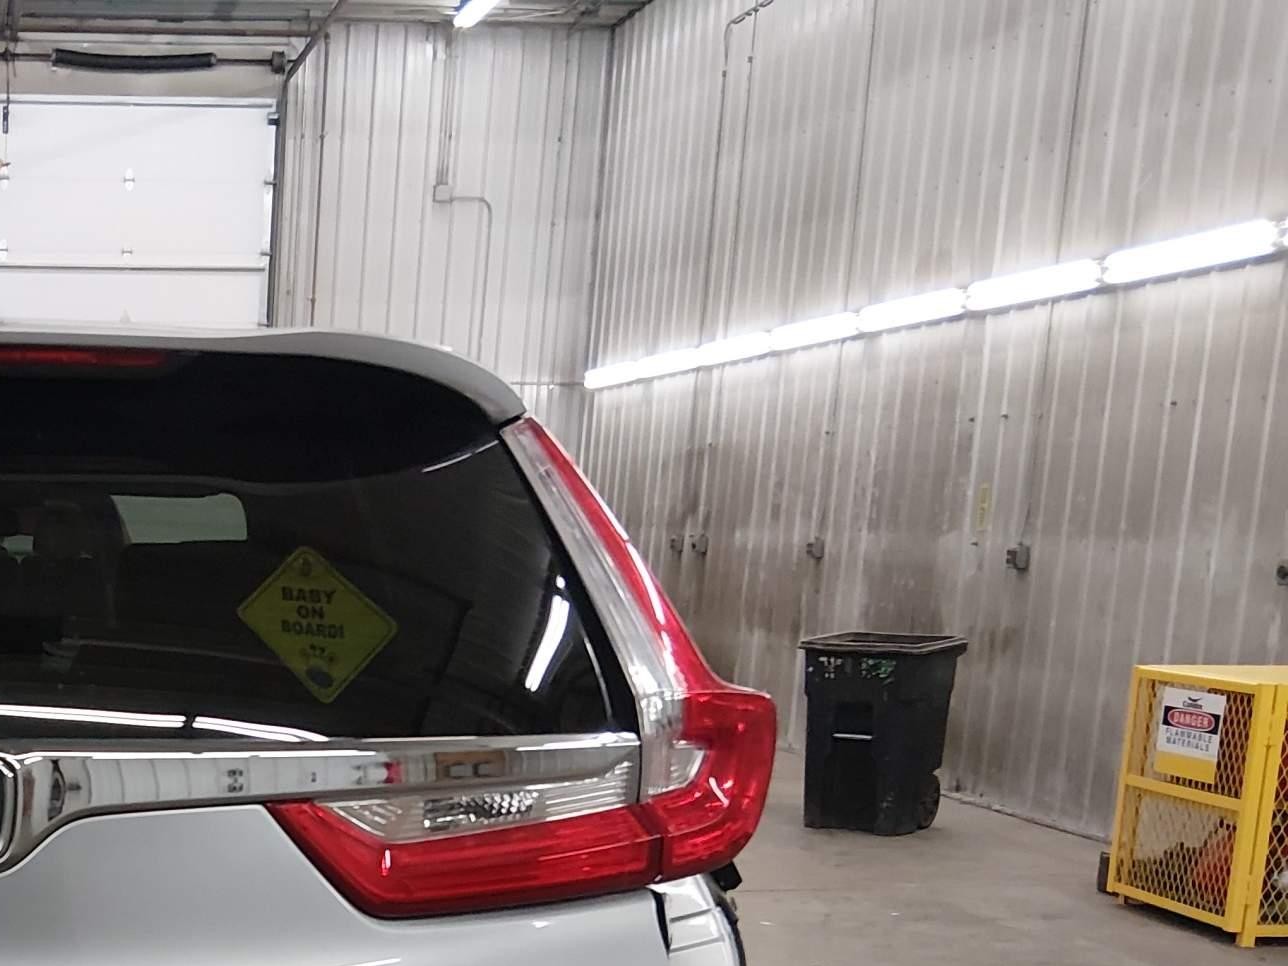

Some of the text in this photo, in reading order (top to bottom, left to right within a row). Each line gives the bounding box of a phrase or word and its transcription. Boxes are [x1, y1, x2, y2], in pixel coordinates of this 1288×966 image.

[281, 586, 336, 604] BABY
[296, 605, 325, 619] ON
[281, 620, 344, 639] BOARD!
[1173, 711, 1209, 729] DANGER
[1165, 727, 1213, 744] FLAMMABLE
[1166, 736, 1210, 752] MATERIALS
